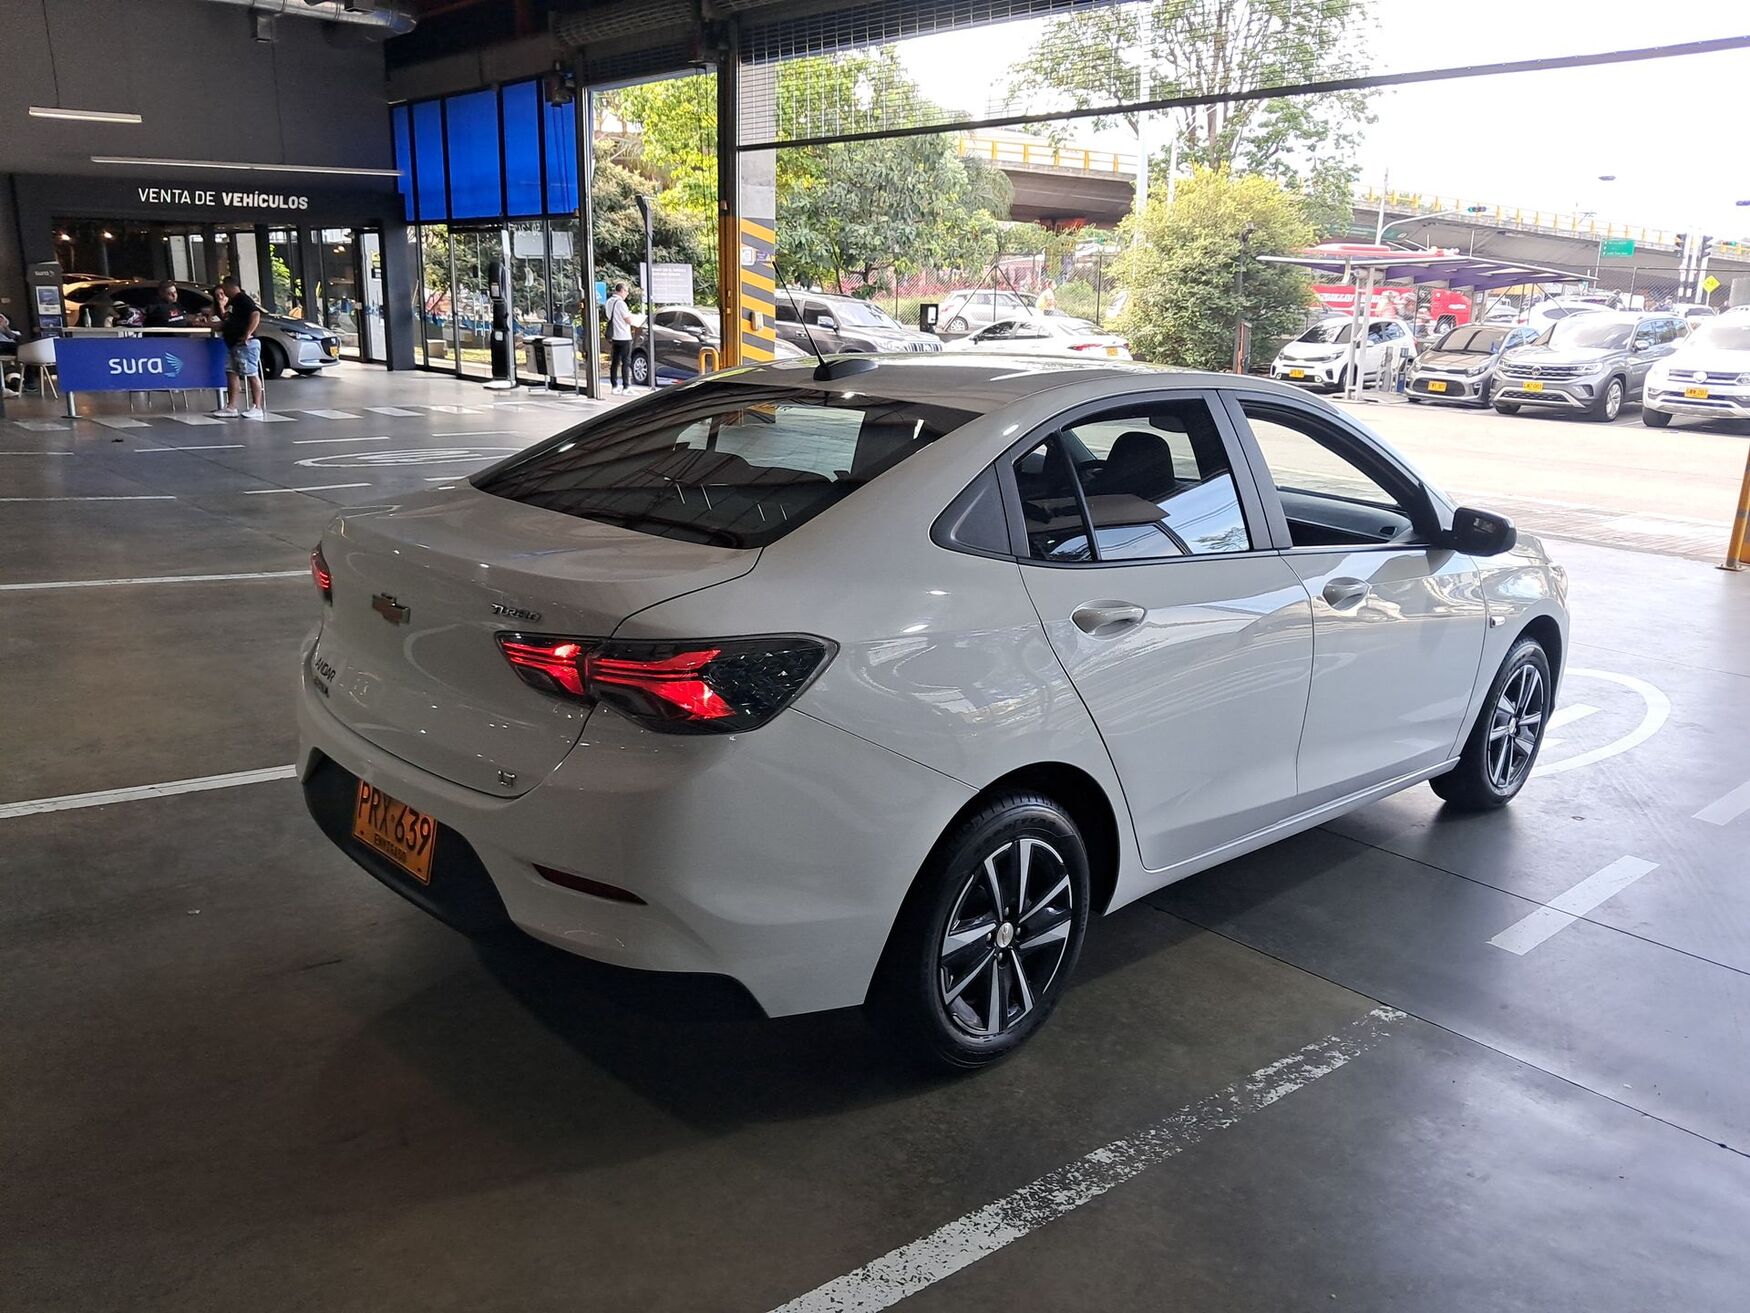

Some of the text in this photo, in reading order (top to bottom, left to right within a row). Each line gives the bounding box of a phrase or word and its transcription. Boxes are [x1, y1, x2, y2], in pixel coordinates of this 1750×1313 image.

[138, 187, 309, 209] VENTA DE VEHÍCULOS
[108, 357, 163, 374] sura
